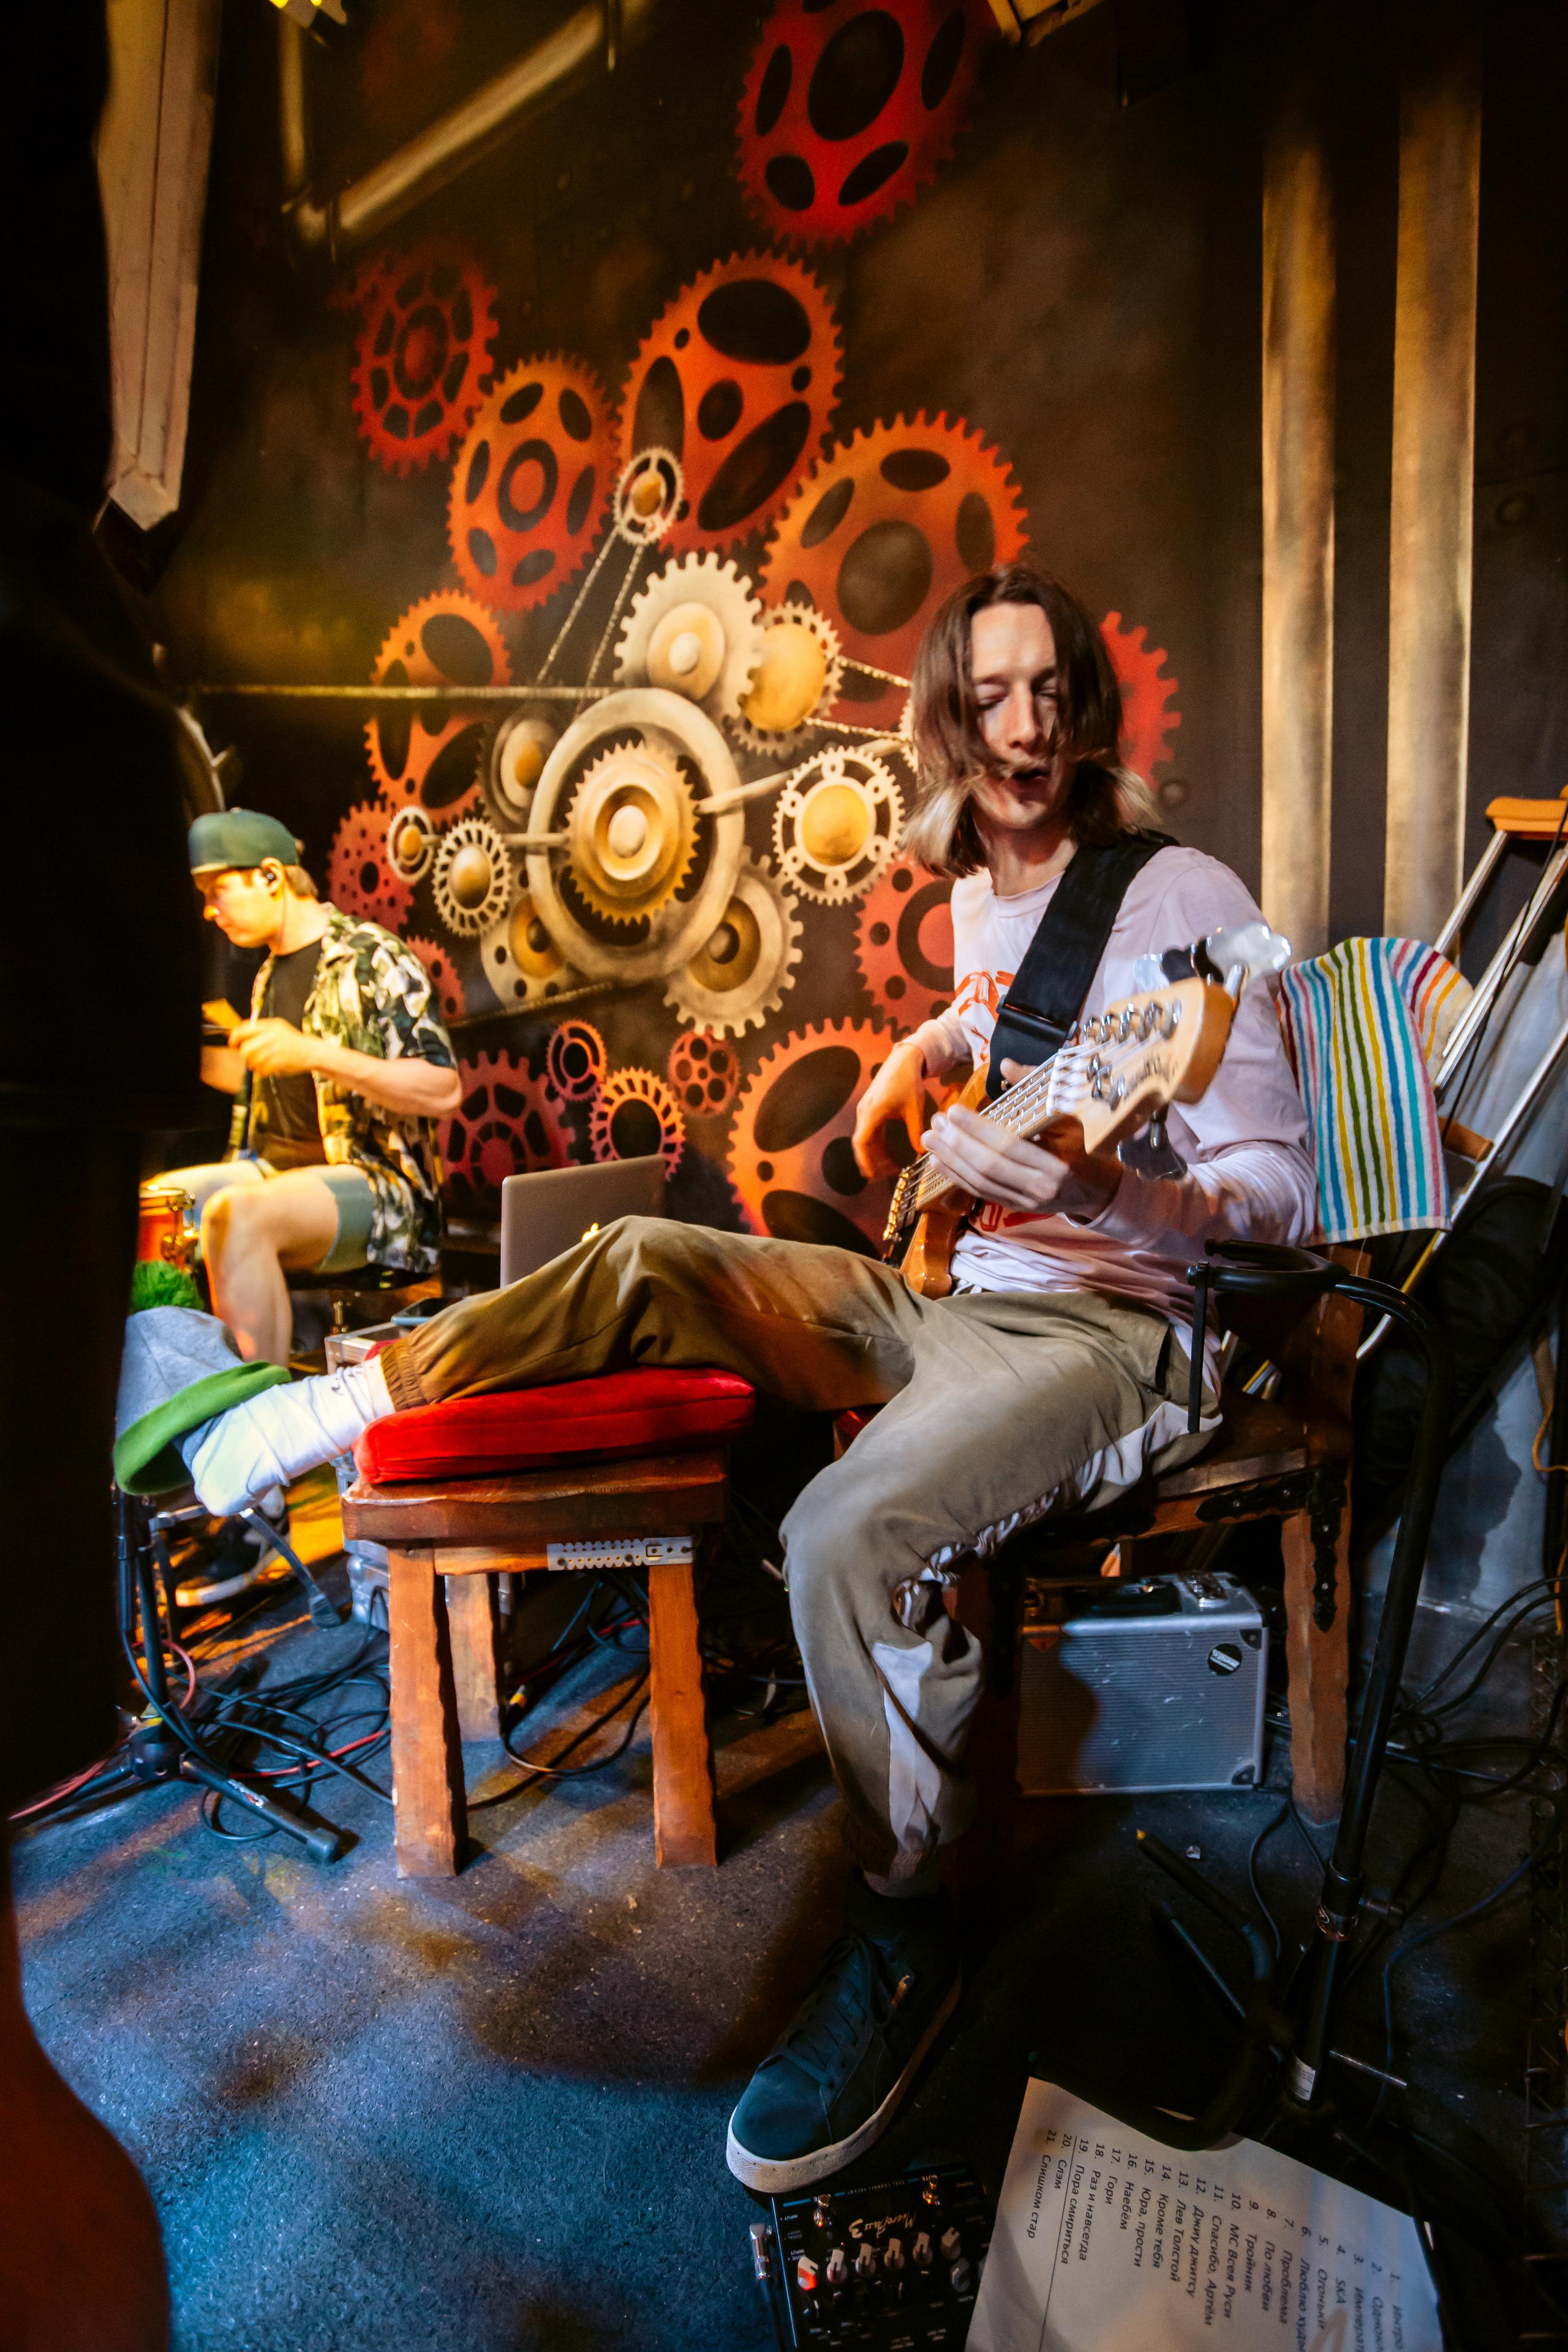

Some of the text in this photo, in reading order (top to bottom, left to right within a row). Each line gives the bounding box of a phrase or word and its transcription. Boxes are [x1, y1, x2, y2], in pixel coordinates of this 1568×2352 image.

[1027, 2129, 1057, 2239] 21. Слишком стар
[1054, 2133, 1072, 2189] 20. Слэм
[1105, 2147, 1121, 2205] 17. Гори
[1120, 2153, 1137, 2230] 16. Наебём
[849, 2218, 864, 2239] 3
[1061, 2138, 1089, 2264] 19. Пора смириться
[1079, 2143, 1105, 2261] 18. Раз и навсегда
[1133, 2158, 1155, 2267] 15. Юра, прости
[1152, 2164, 1172, 2269] 14. Кроме тебя
[1170, 2171, 1188, 2282] 13. Лев Толстой
[1186, 2177, 1207, 2298] 12. Джиу джитсу
[1231, 2193, 1242, 2210] 10.
[1301, 2226, 1311, 2237] 6.
[1204, 2184, 1224, 2326] 11. Спасибо, Артём
[1227, 2248, 1238, 2282] Всея
[1244, 2200, 1259, 2293] 9. Тройник
[1262, 2208, 1276, 2312] 8. По любви
[1280, 2217, 1294, 2324] 7. Проблема
[1298, 2258, 1310, 2312] Люблю
[1317, 2235, 1329, 2329] 5. Огоньки
[1336, 2244, 1346, 2304] 4. SKA
[1354, 2253, 1365, 2264] 3.
[1371, 2262, 1382, 2273] 2.
[1223, 2284, 1236, 2319] Руси
[1392, 2305, 1404, 2350] Интро
